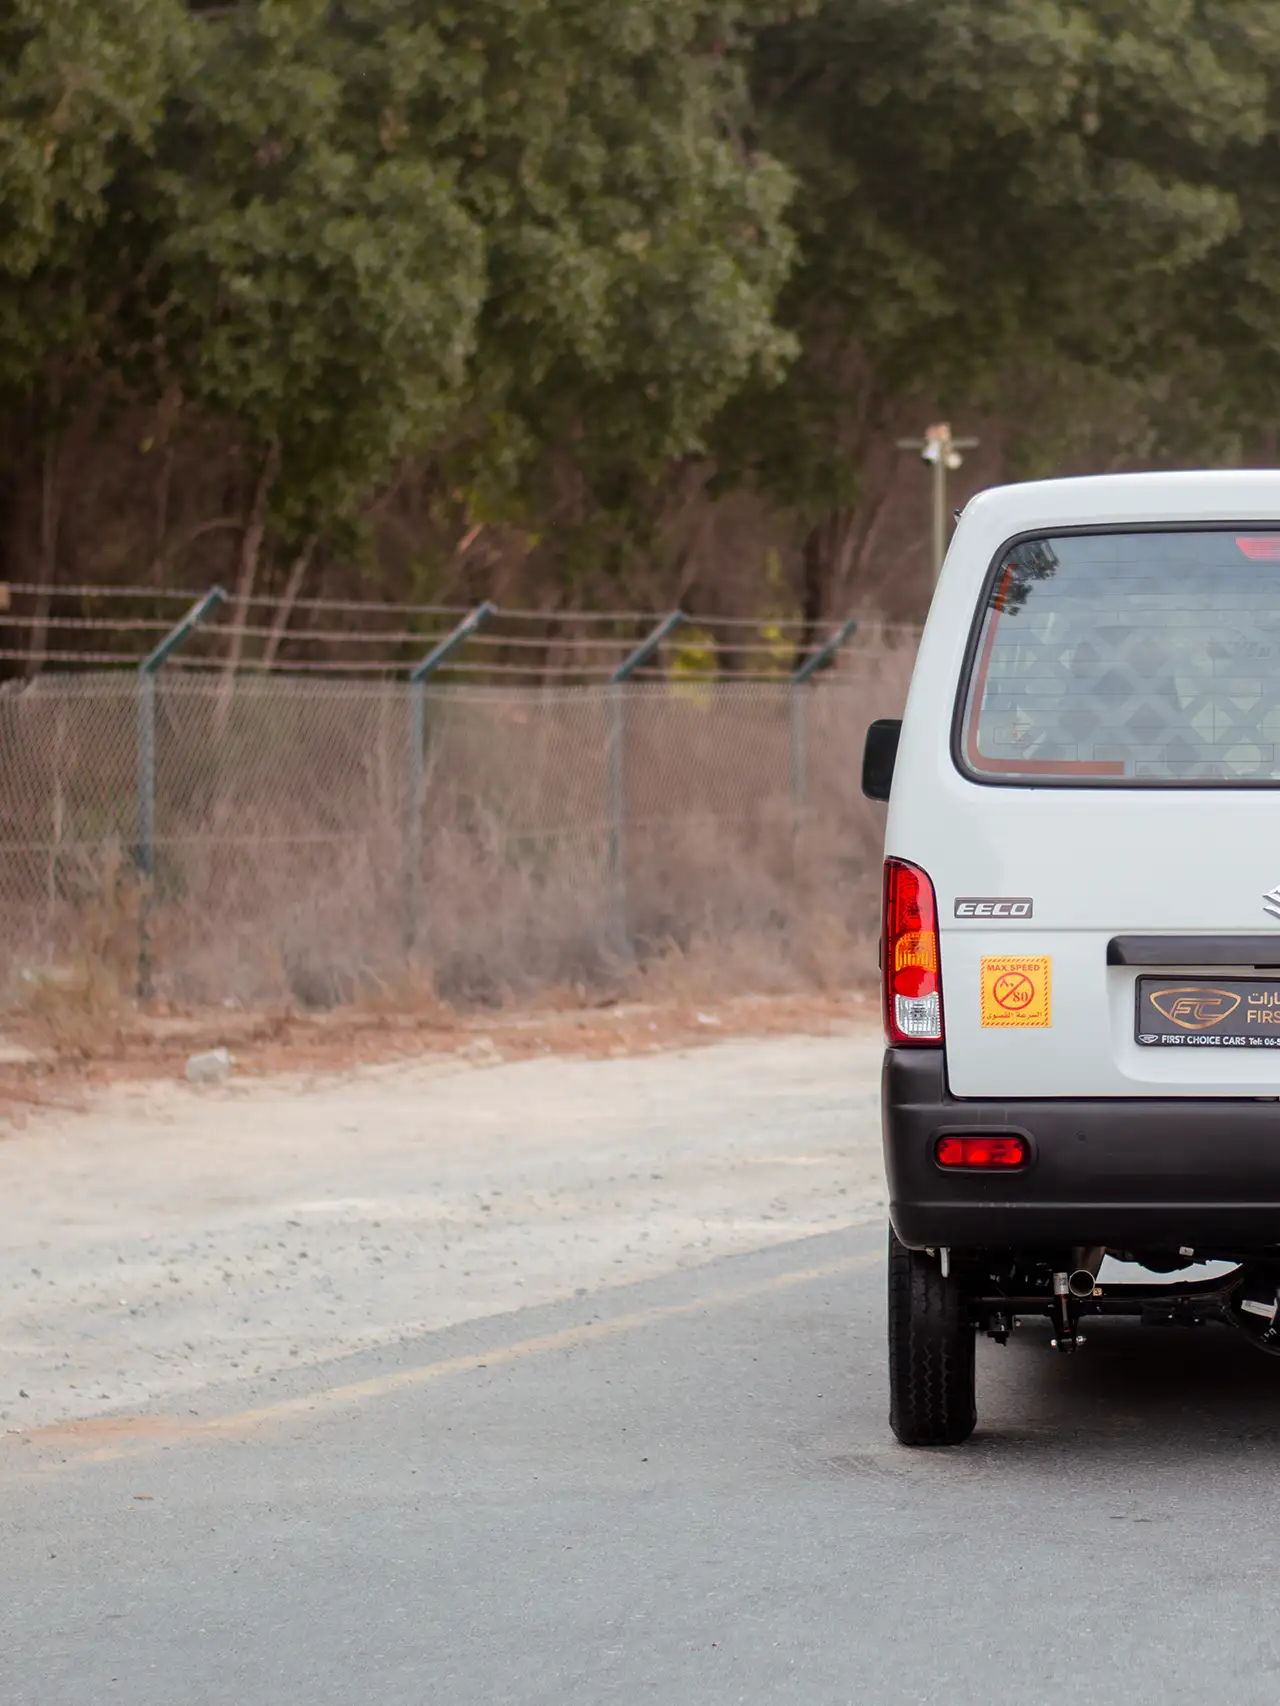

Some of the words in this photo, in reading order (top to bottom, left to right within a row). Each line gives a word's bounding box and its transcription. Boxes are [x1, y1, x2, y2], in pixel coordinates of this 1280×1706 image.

[956, 903, 1030, 916] EECO
[1013, 991, 1028, 1002] 80
[1161, 1035, 1185, 1044] FIRST
[1187, 1036, 1221, 1045] CHOICE
[1222, 1036, 1246, 1045] CARS
[1248, 1037, 1262, 1045] Tel:
